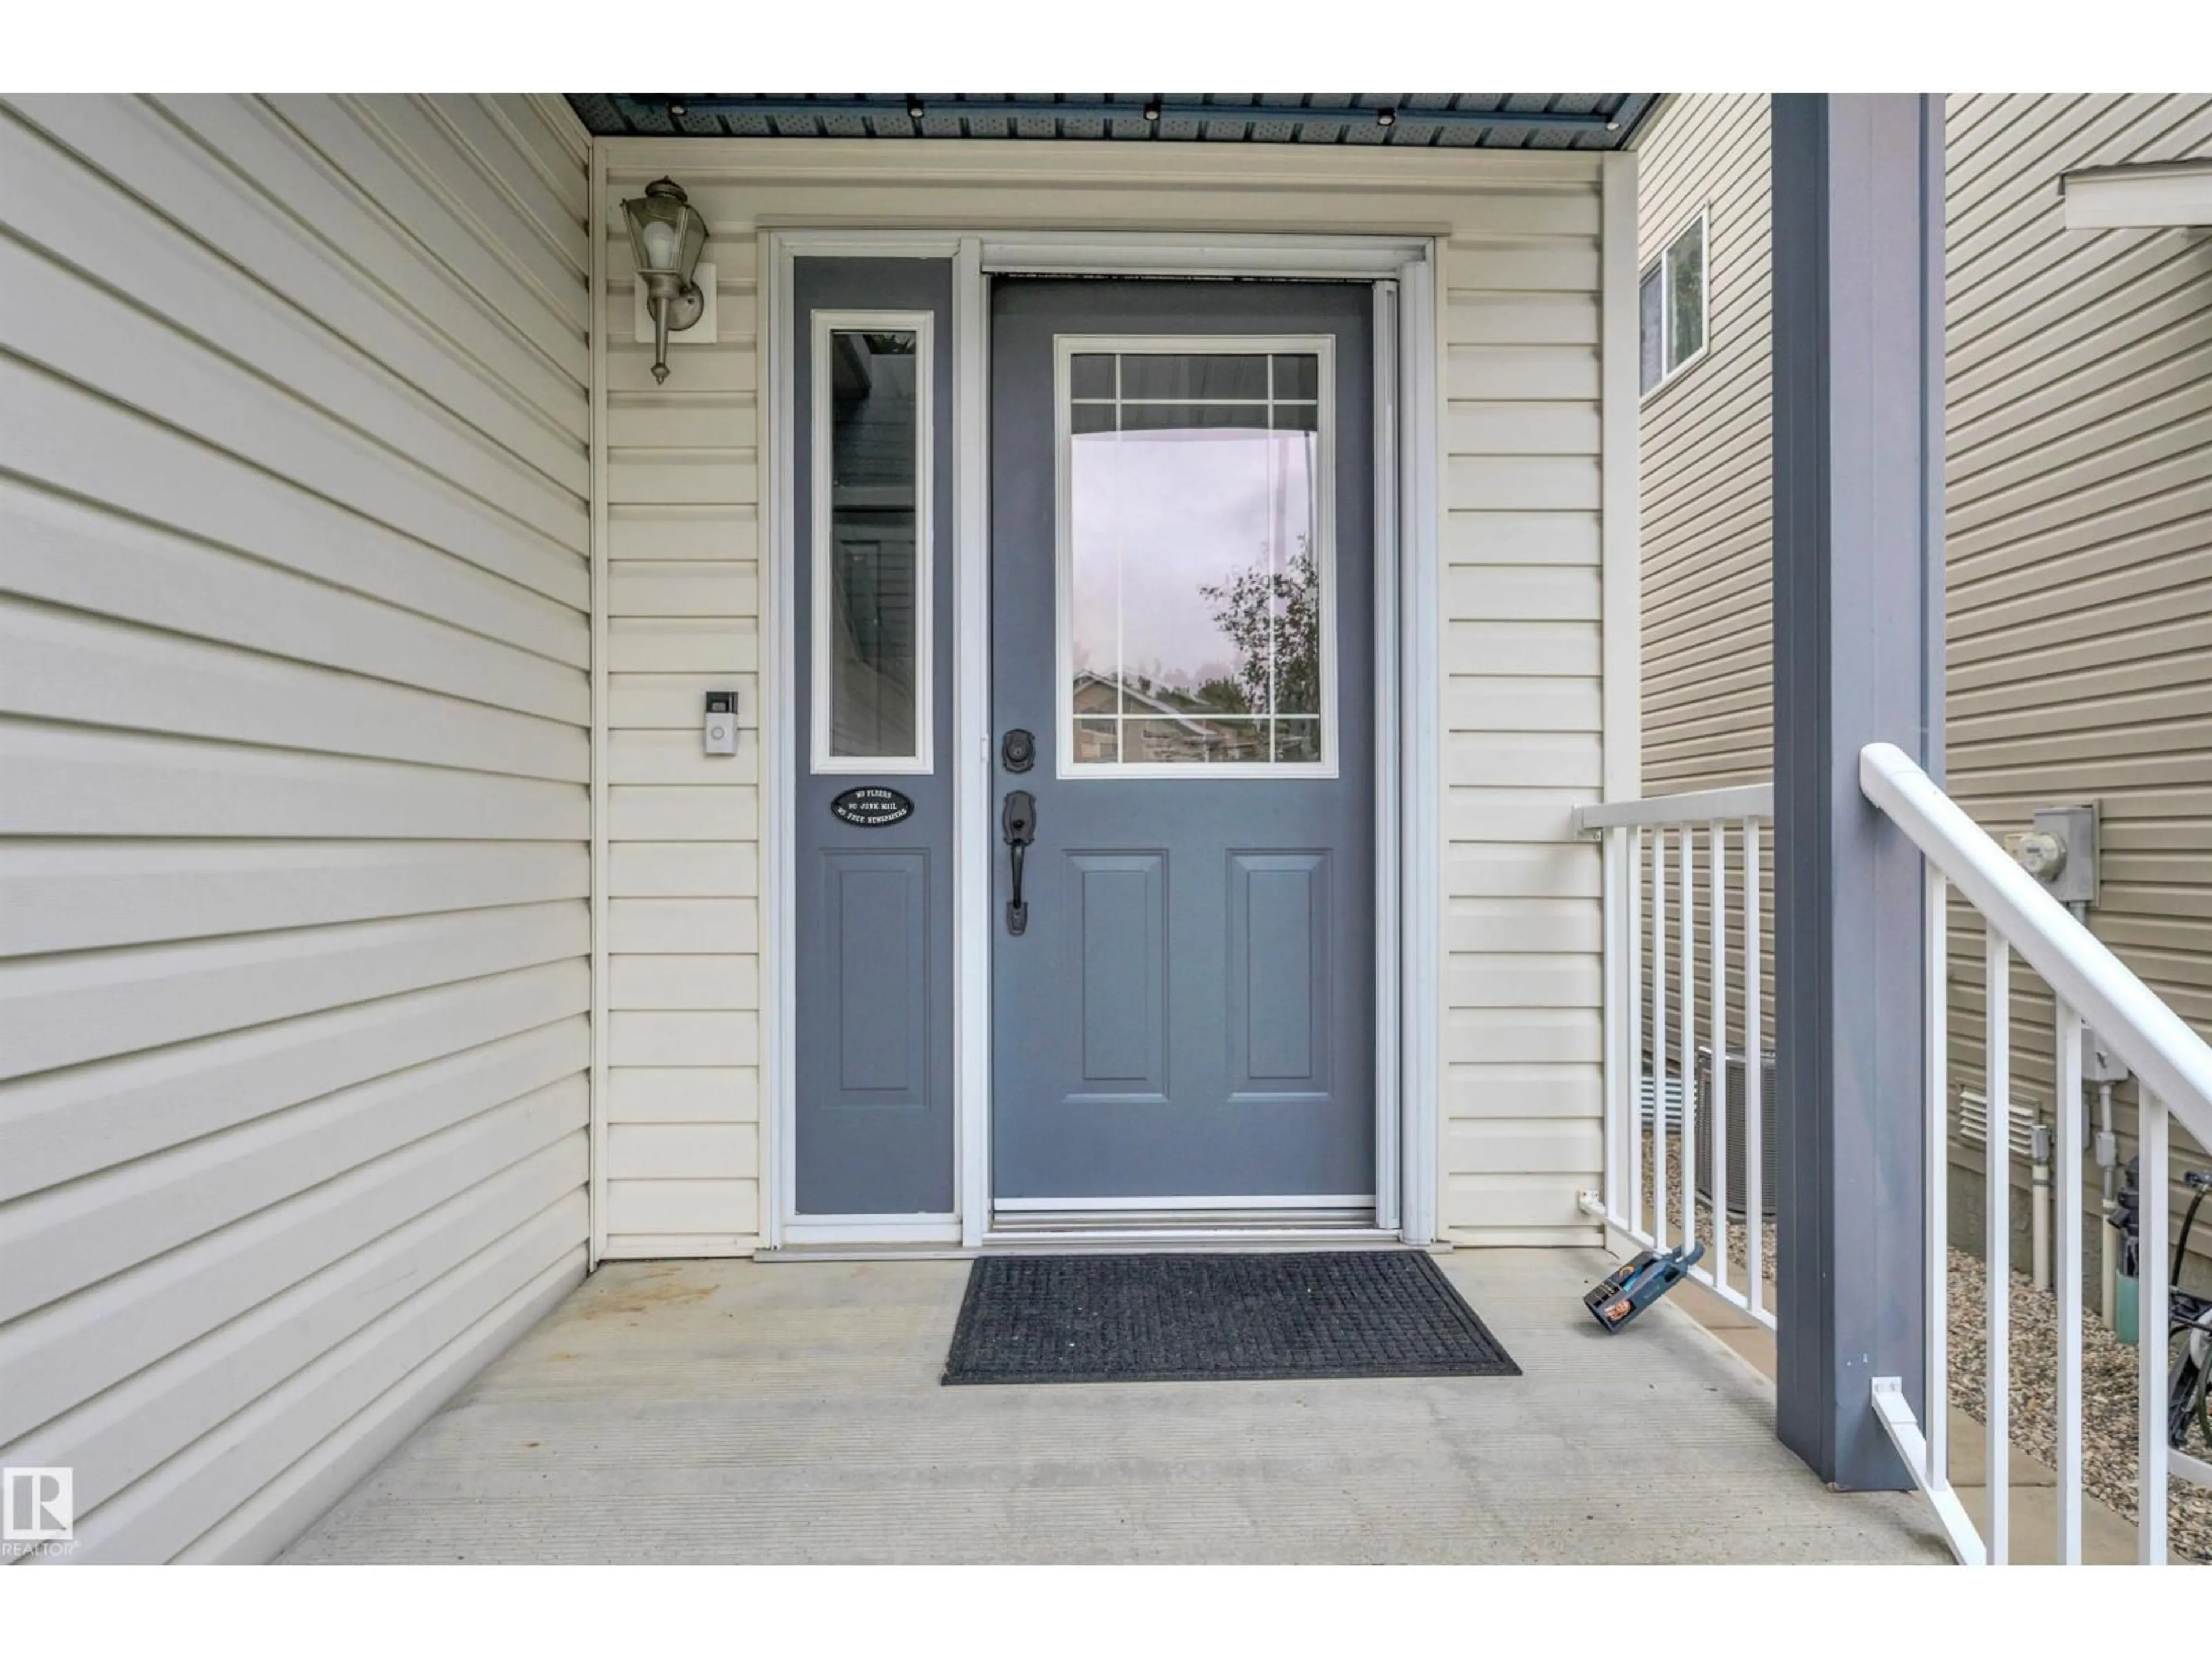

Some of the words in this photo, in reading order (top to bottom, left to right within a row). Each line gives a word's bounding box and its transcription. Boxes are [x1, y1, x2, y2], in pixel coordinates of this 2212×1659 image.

[855, 790, 865, 798] NO
[838, 807, 847, 816] NO
[847, 813, 865, 823] FREE
